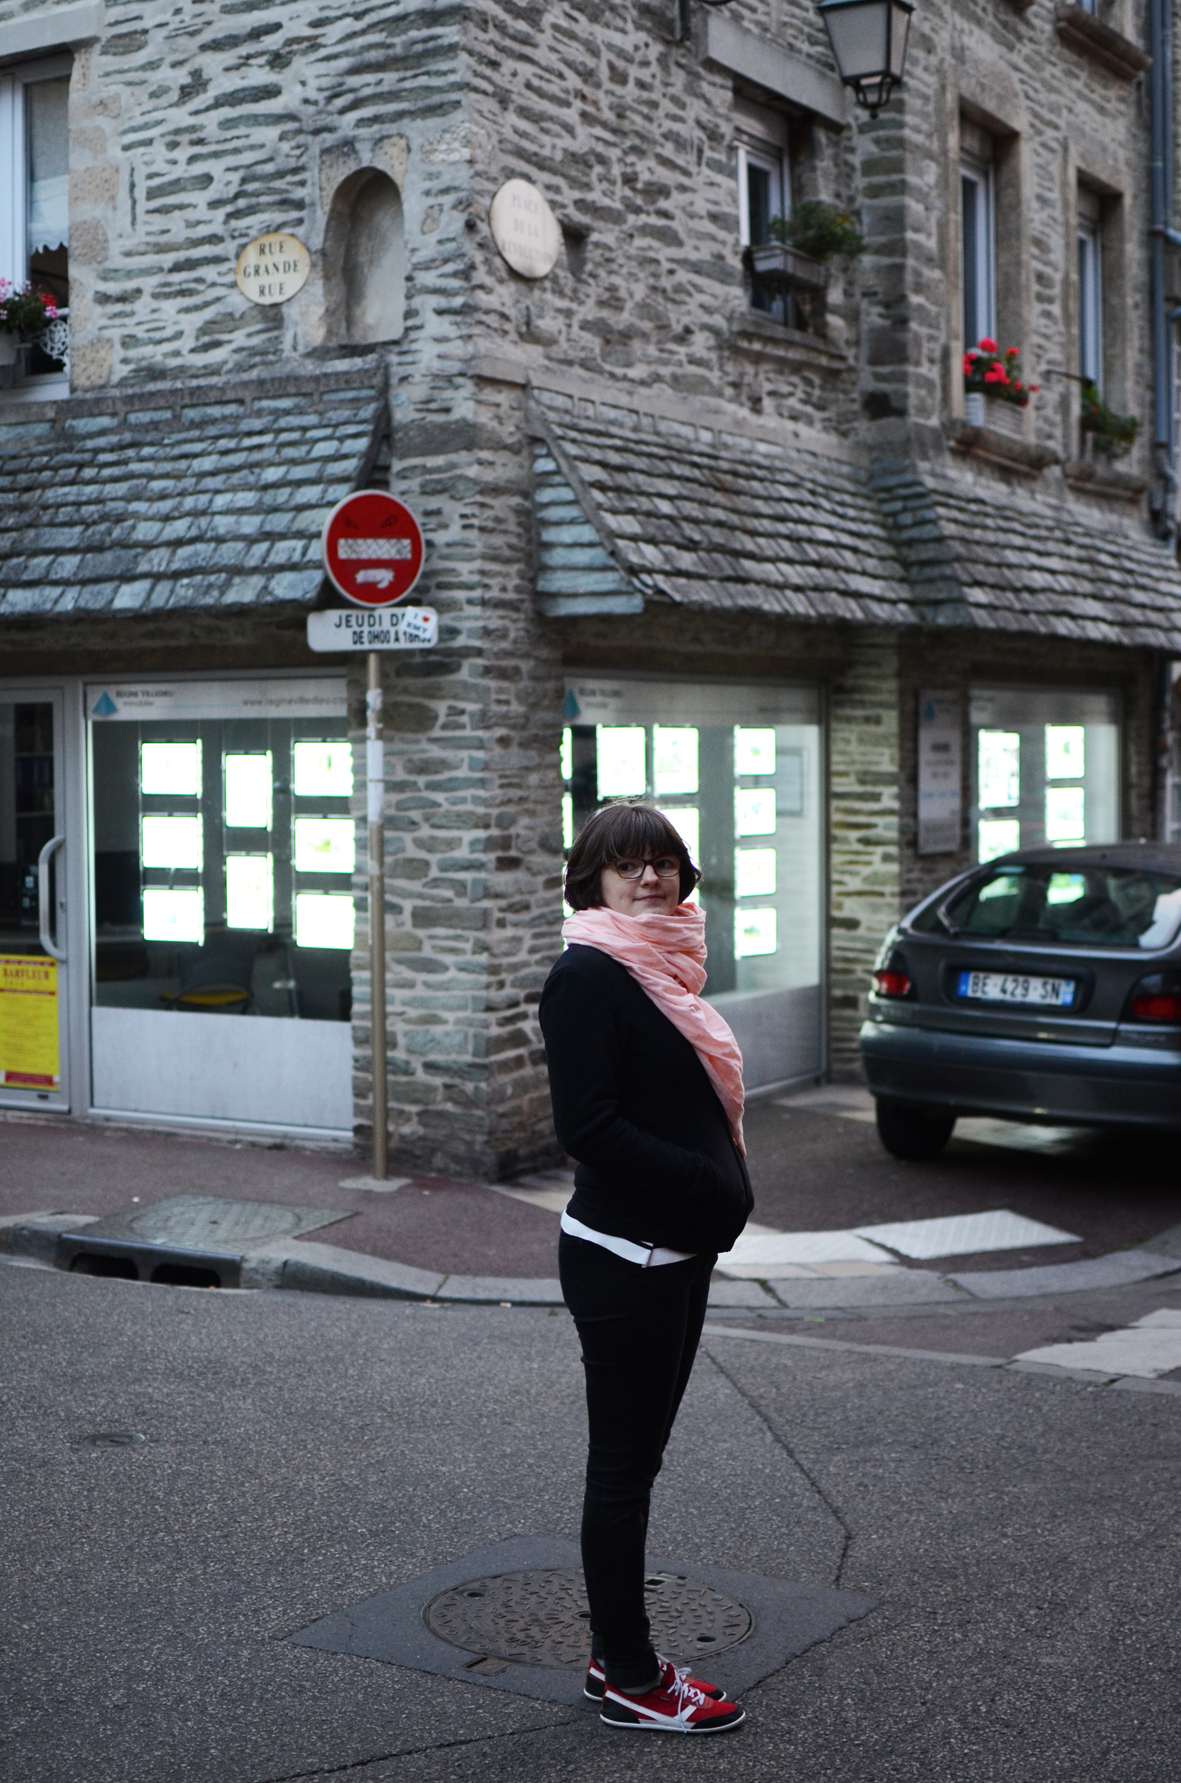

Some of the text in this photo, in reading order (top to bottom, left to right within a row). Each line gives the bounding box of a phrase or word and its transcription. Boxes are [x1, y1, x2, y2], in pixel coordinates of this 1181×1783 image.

[258, 241, 286, 257] RUE
[243, 260, 300, 278] GRANDE
[258, 282, 285, 298] RUE
[334, 613, 382, 628] JEUDI
[352, 630, 365, 645] DE
